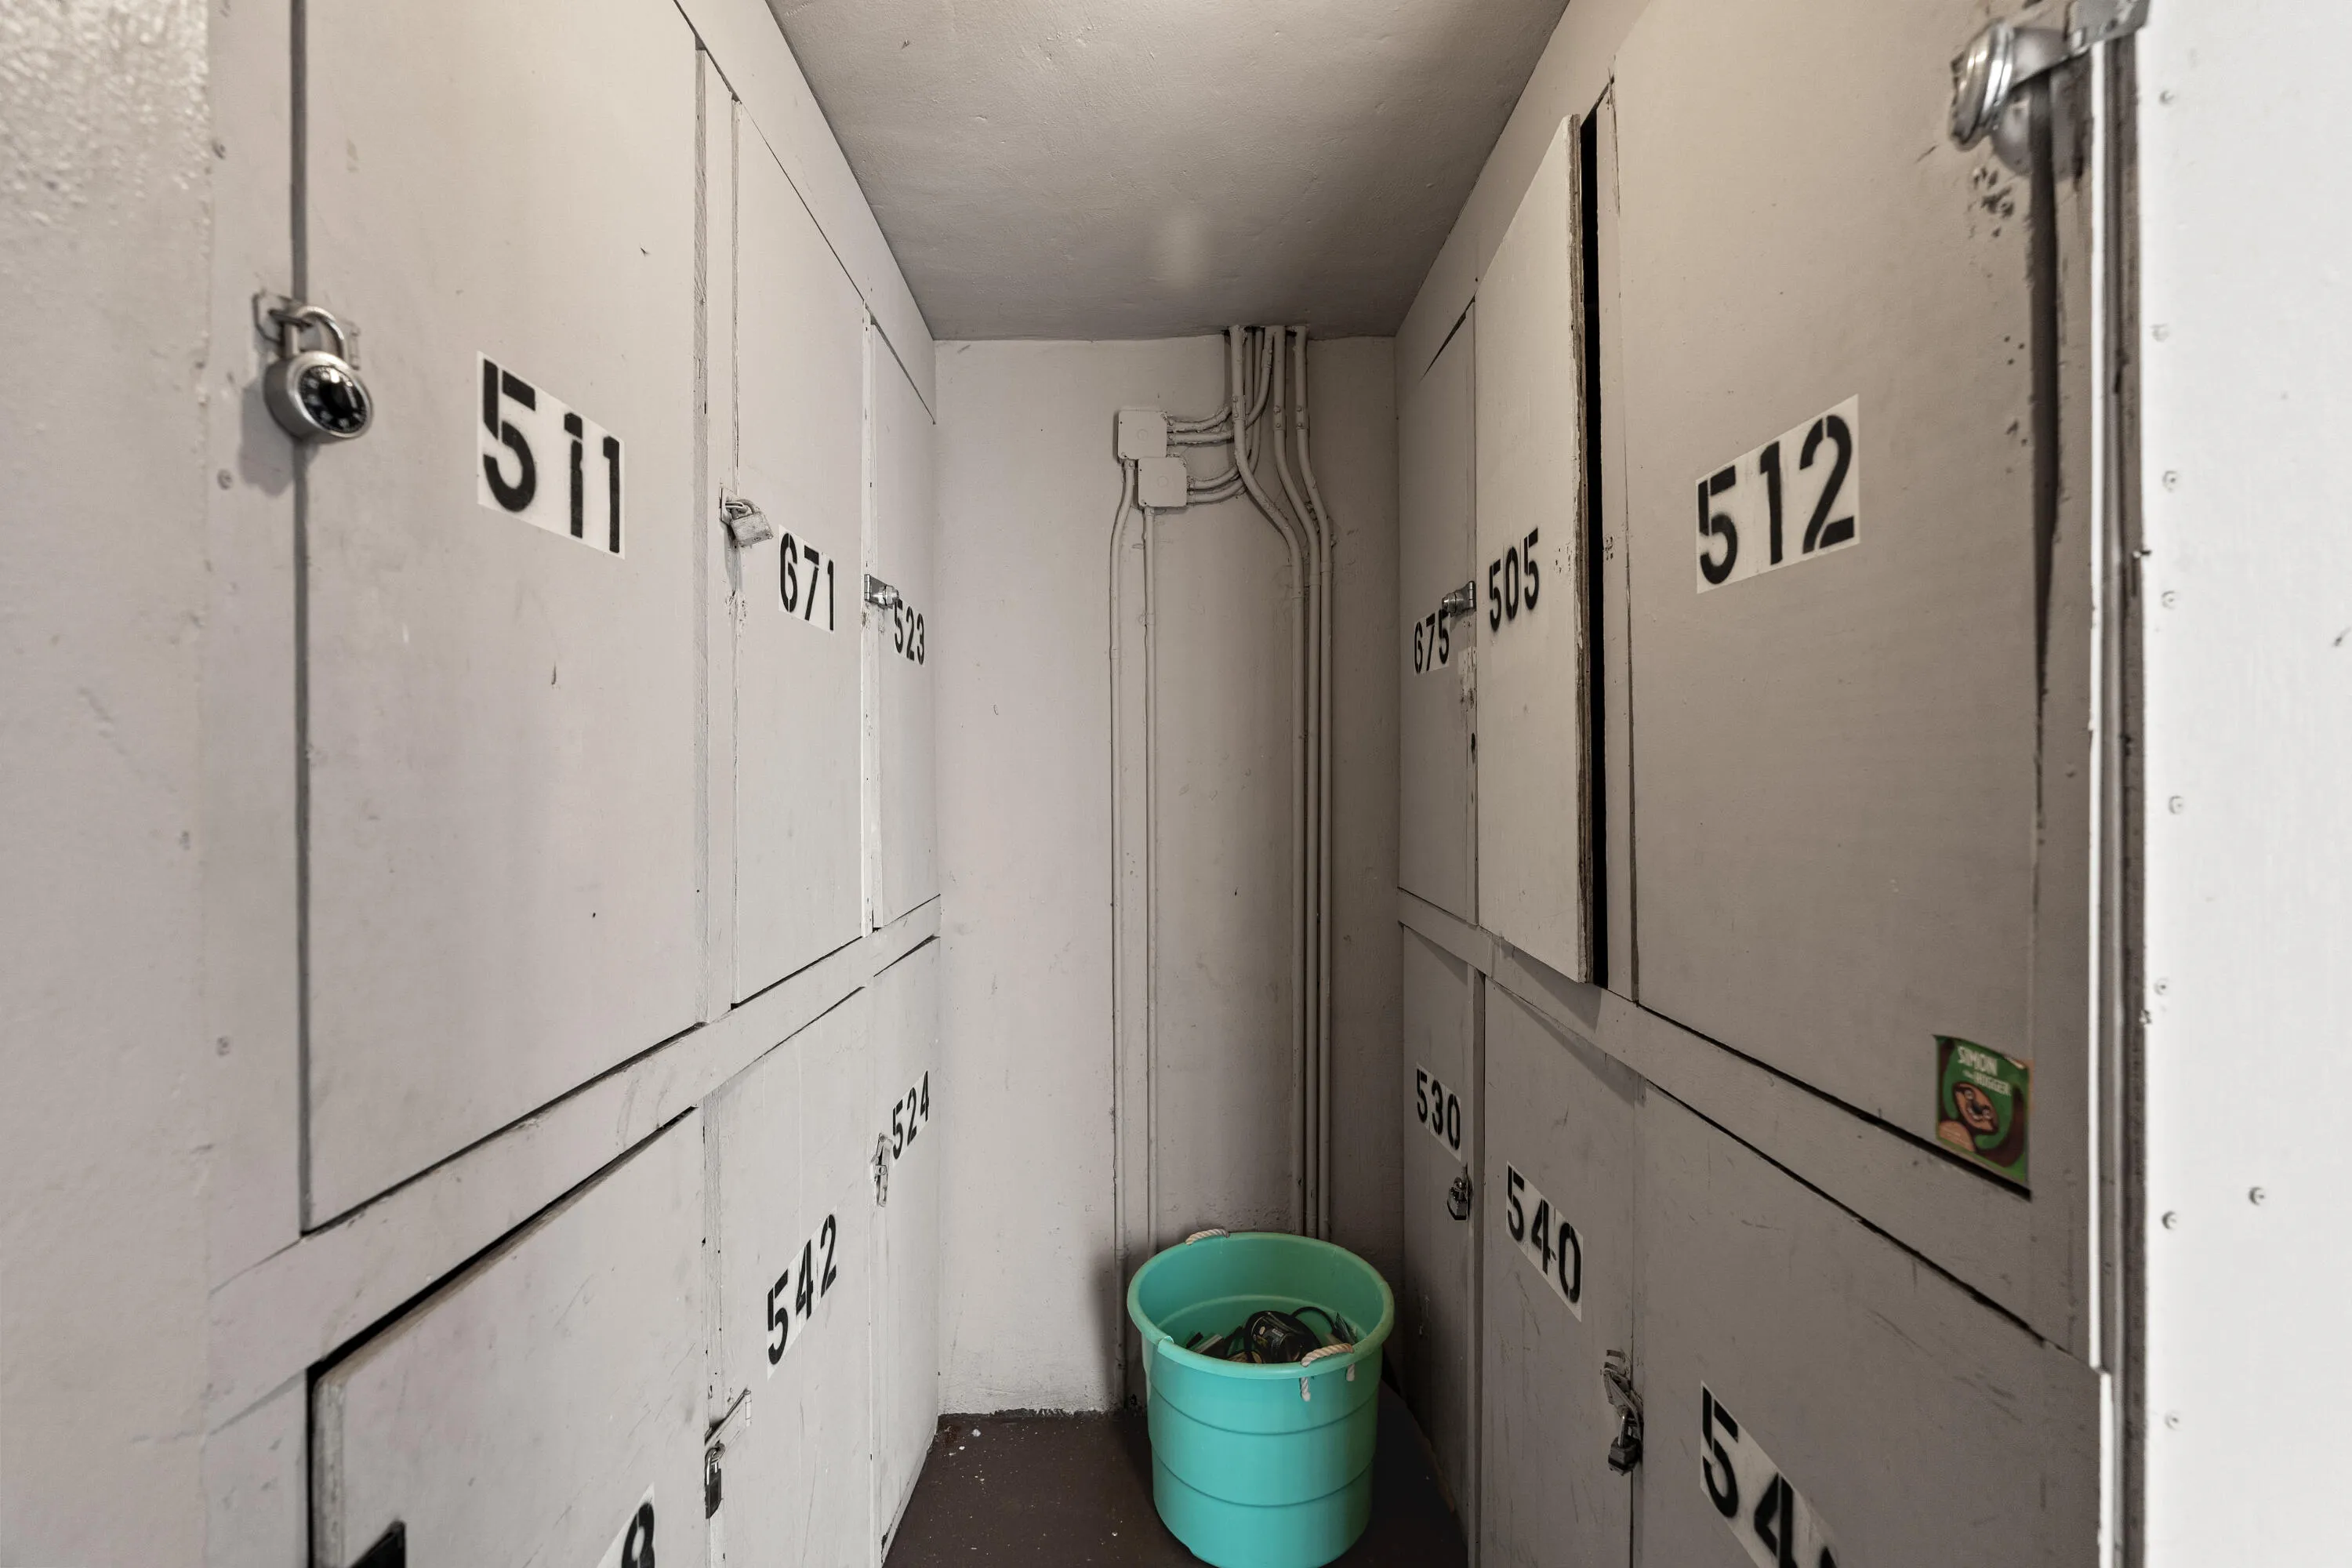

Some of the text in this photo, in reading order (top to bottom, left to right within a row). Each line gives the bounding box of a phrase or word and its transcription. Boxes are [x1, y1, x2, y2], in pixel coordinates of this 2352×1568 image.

[484, 359, 619, 554] 511
[1698, 415, 1854, 585] 512
[780, 532, 834, 631] 671
[894, 598, 924, 666] 523
[1490, 528, 1539, 632] 505
[1414, 608, 1450, 673] 675
[892, 1070, 929, 1160] 524
[1417, 1068, 1461, 1150] 530
[1507, 1165, 1581, 1304] 540
[768, 1214, 837, 1365] 542
[1703, 1385, 1838, 1568] 54
